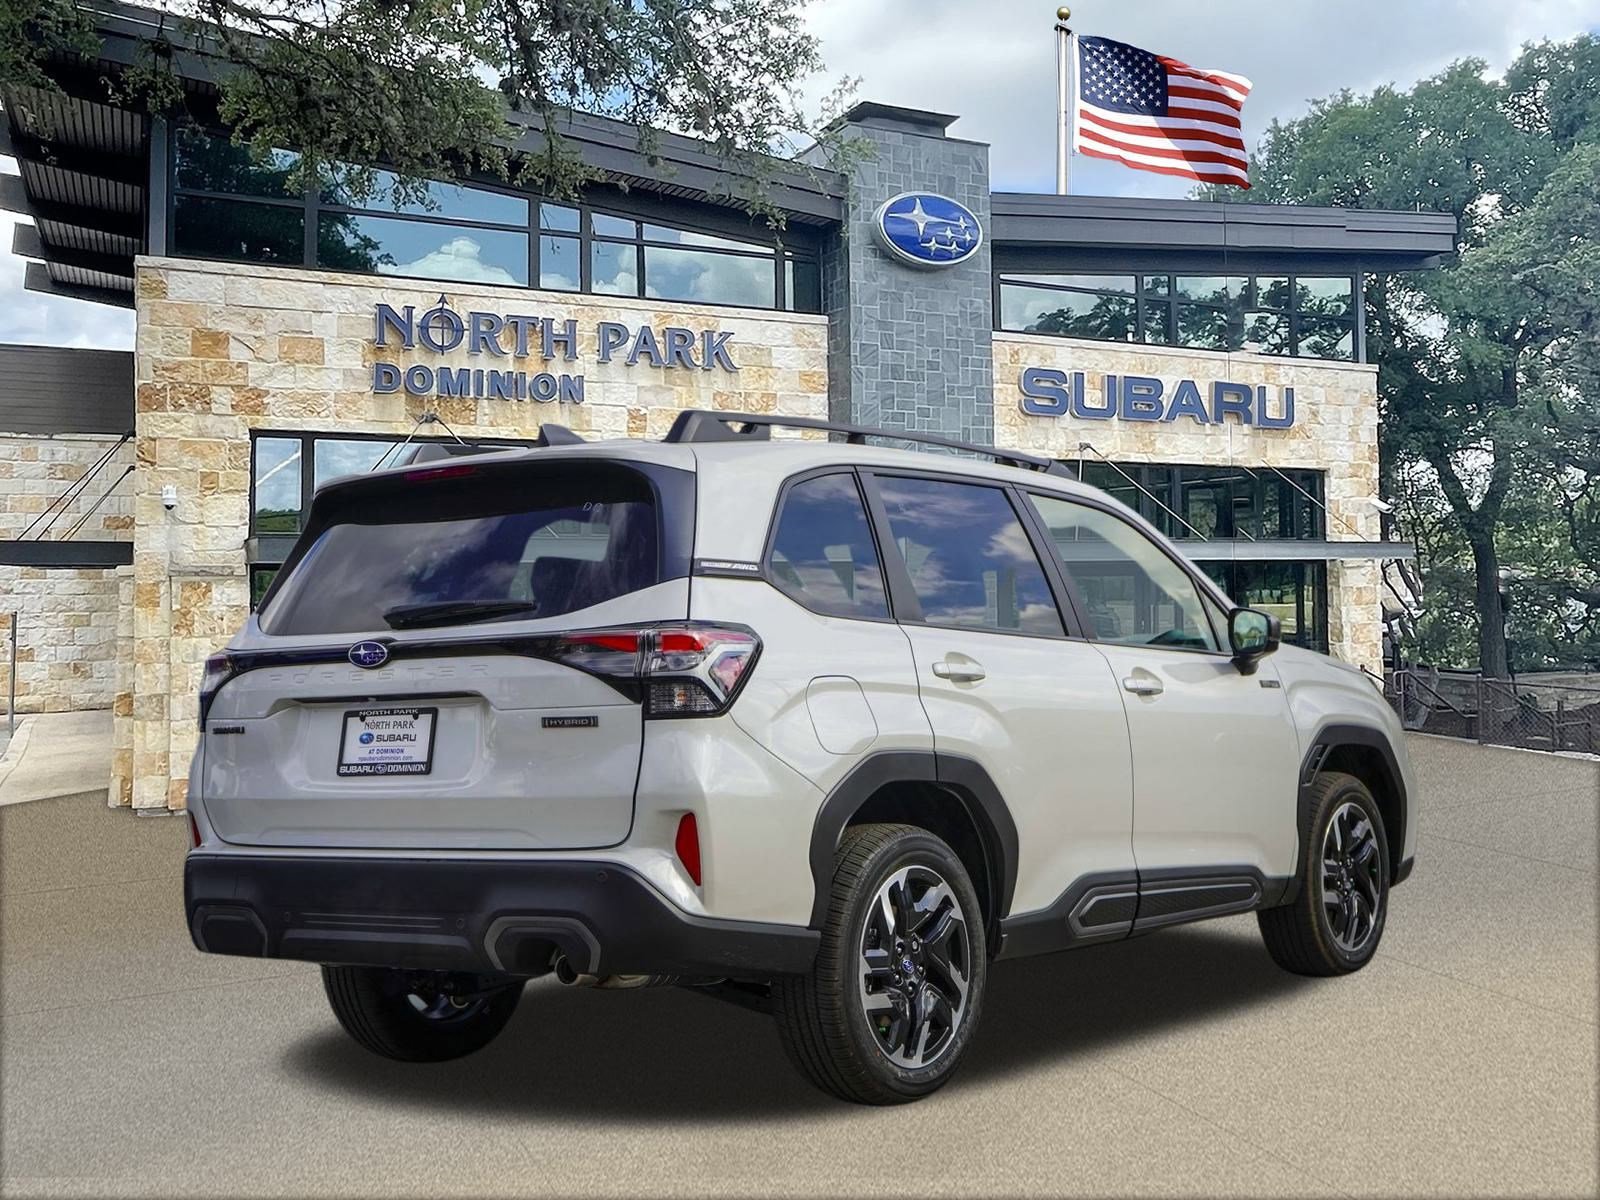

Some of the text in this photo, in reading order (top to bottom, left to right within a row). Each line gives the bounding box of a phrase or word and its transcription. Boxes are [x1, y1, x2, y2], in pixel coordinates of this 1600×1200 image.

[375, 293, 742, 372] NORTH PARK
[373, 362, 585, 404] DOMINION
[1019, 367, 1295, 429] SUBARU
[269, 664, 489, 685] FORESTER
[364, 719, 415, 730] NORTH PARK
[550, 718, 589, 726] HYBRID
[376, 733, 417, 742] SUBARU
[339, 764, 426, 773] SUBARU DOMINION
